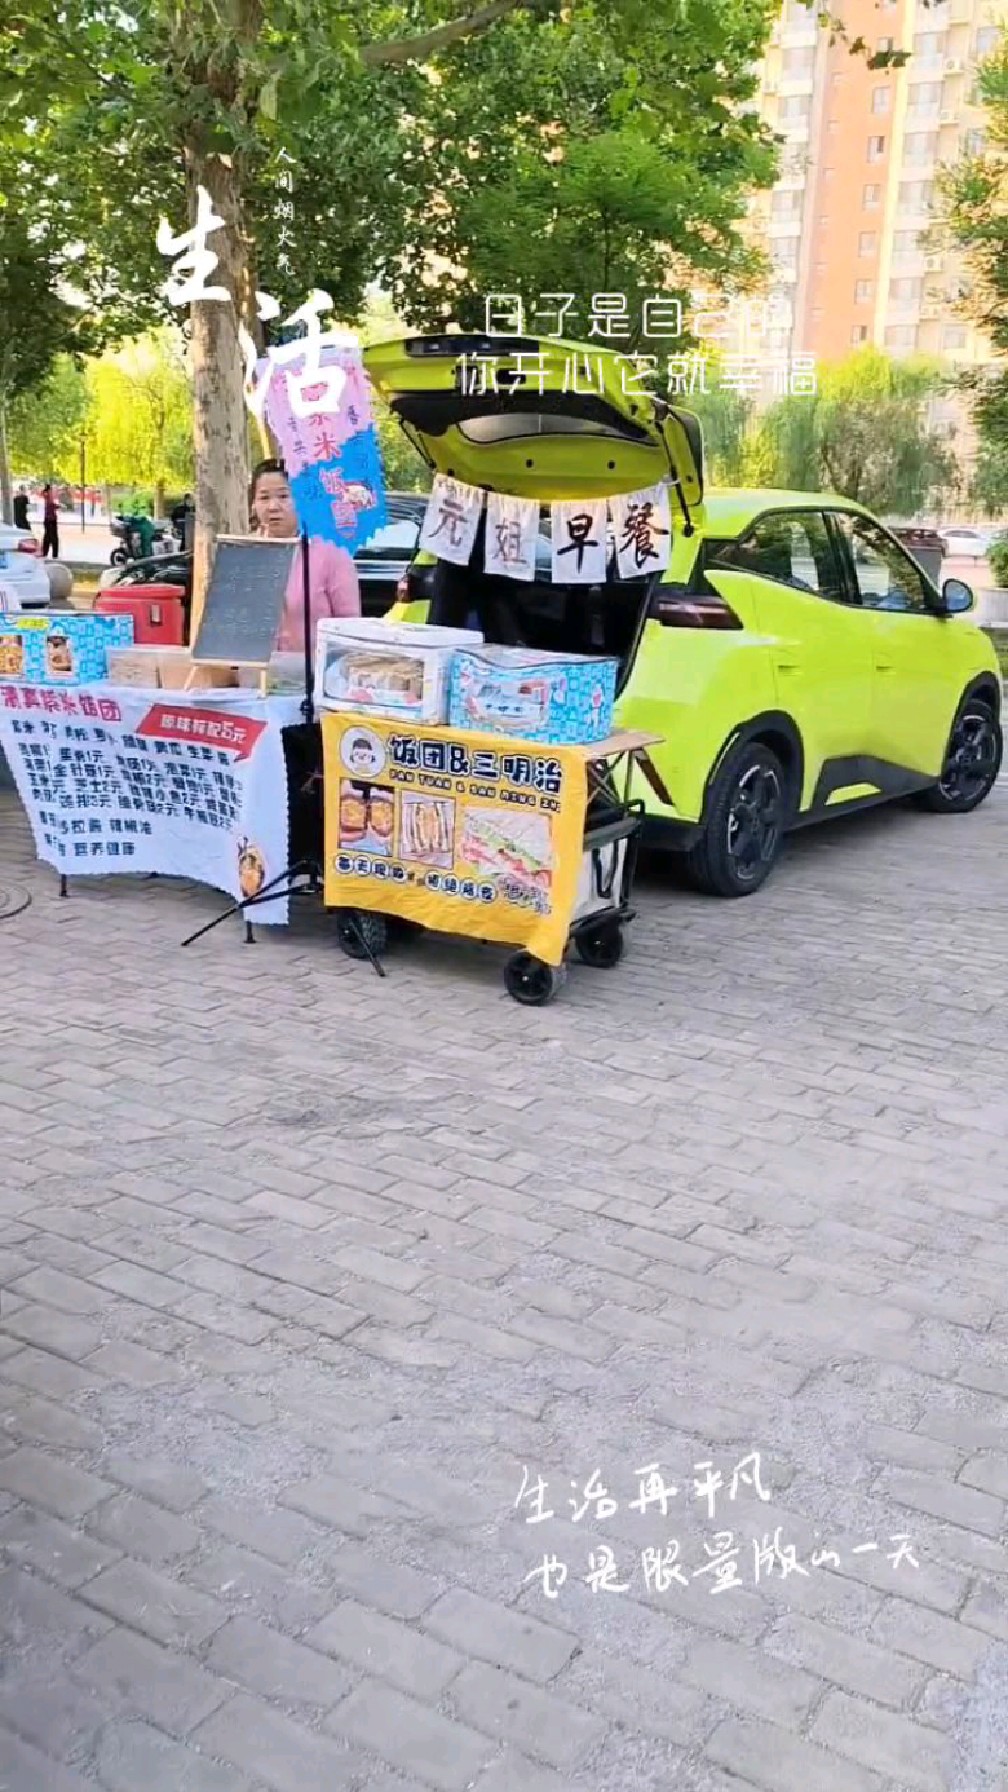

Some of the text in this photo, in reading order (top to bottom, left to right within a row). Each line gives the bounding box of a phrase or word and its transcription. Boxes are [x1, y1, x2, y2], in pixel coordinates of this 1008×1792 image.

[388, 733, 563, 797] 饭团&三明治
